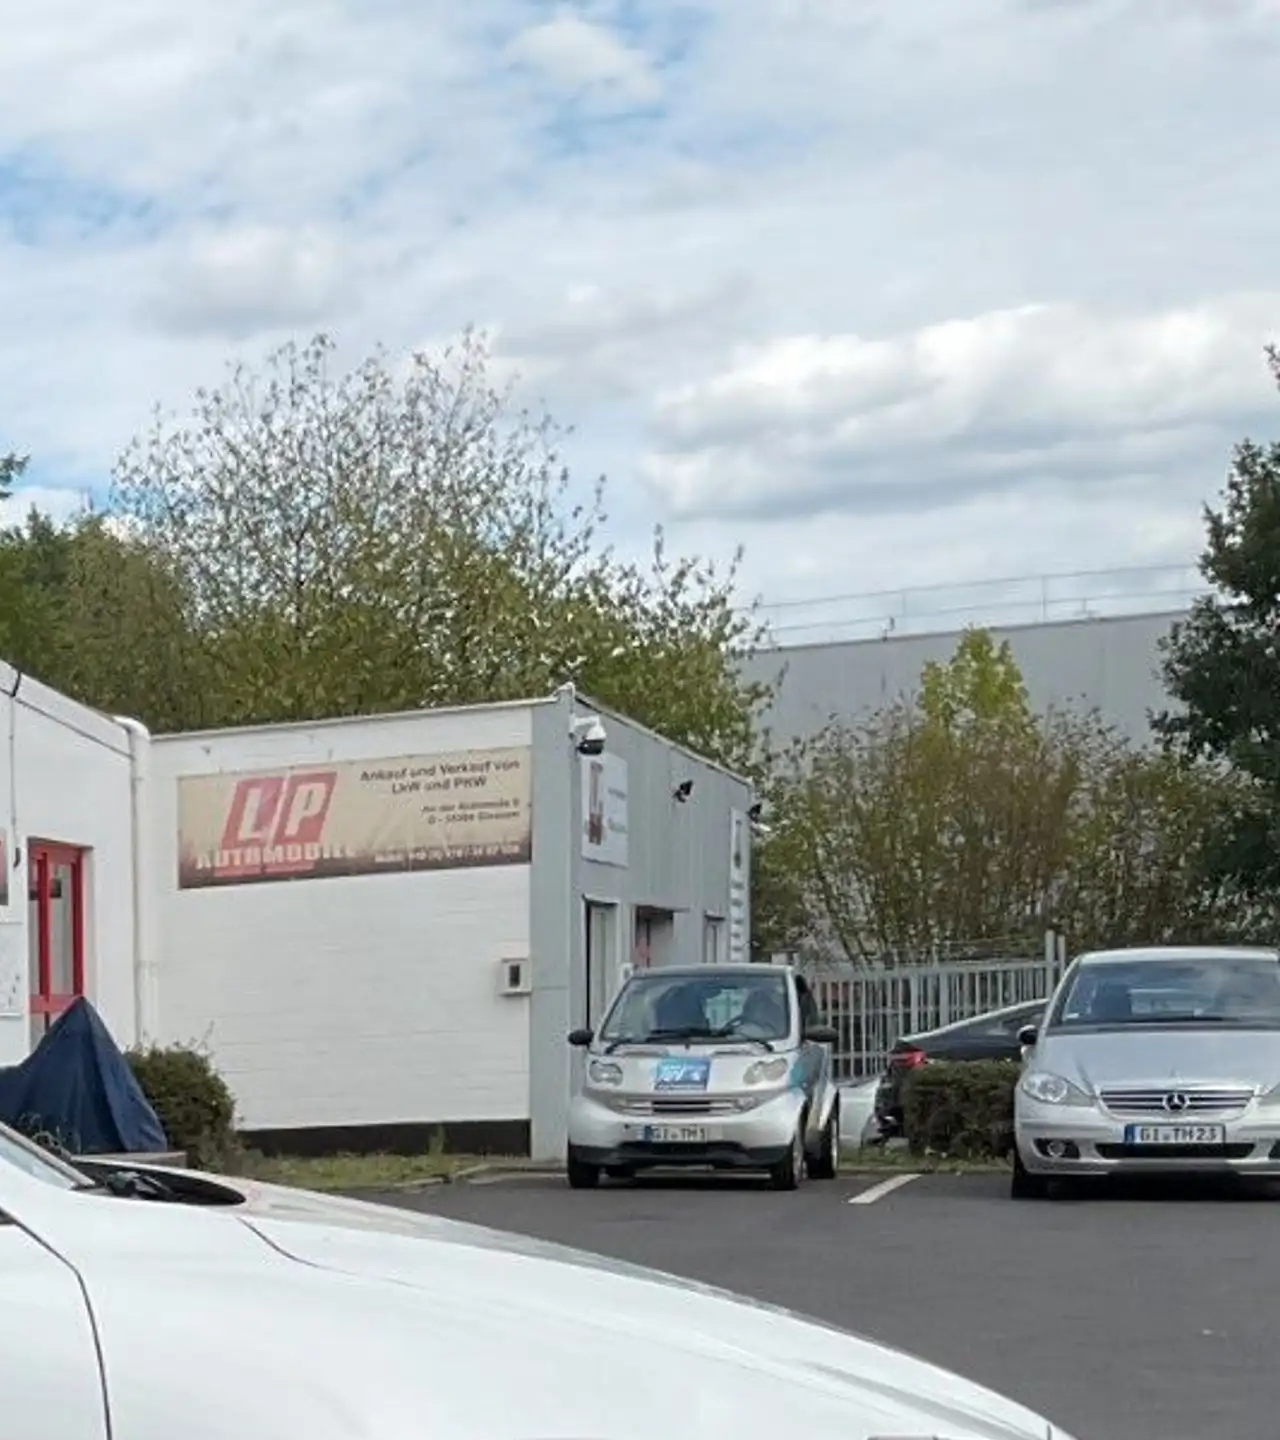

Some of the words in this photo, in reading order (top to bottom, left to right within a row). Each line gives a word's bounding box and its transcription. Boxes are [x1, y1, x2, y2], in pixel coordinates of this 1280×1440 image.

[410, 765, 436, 778] und
[440, 760, 491, 776] Verkauf
[424, 779, 450, 792] und
[232, 778, 332, 844] LP
